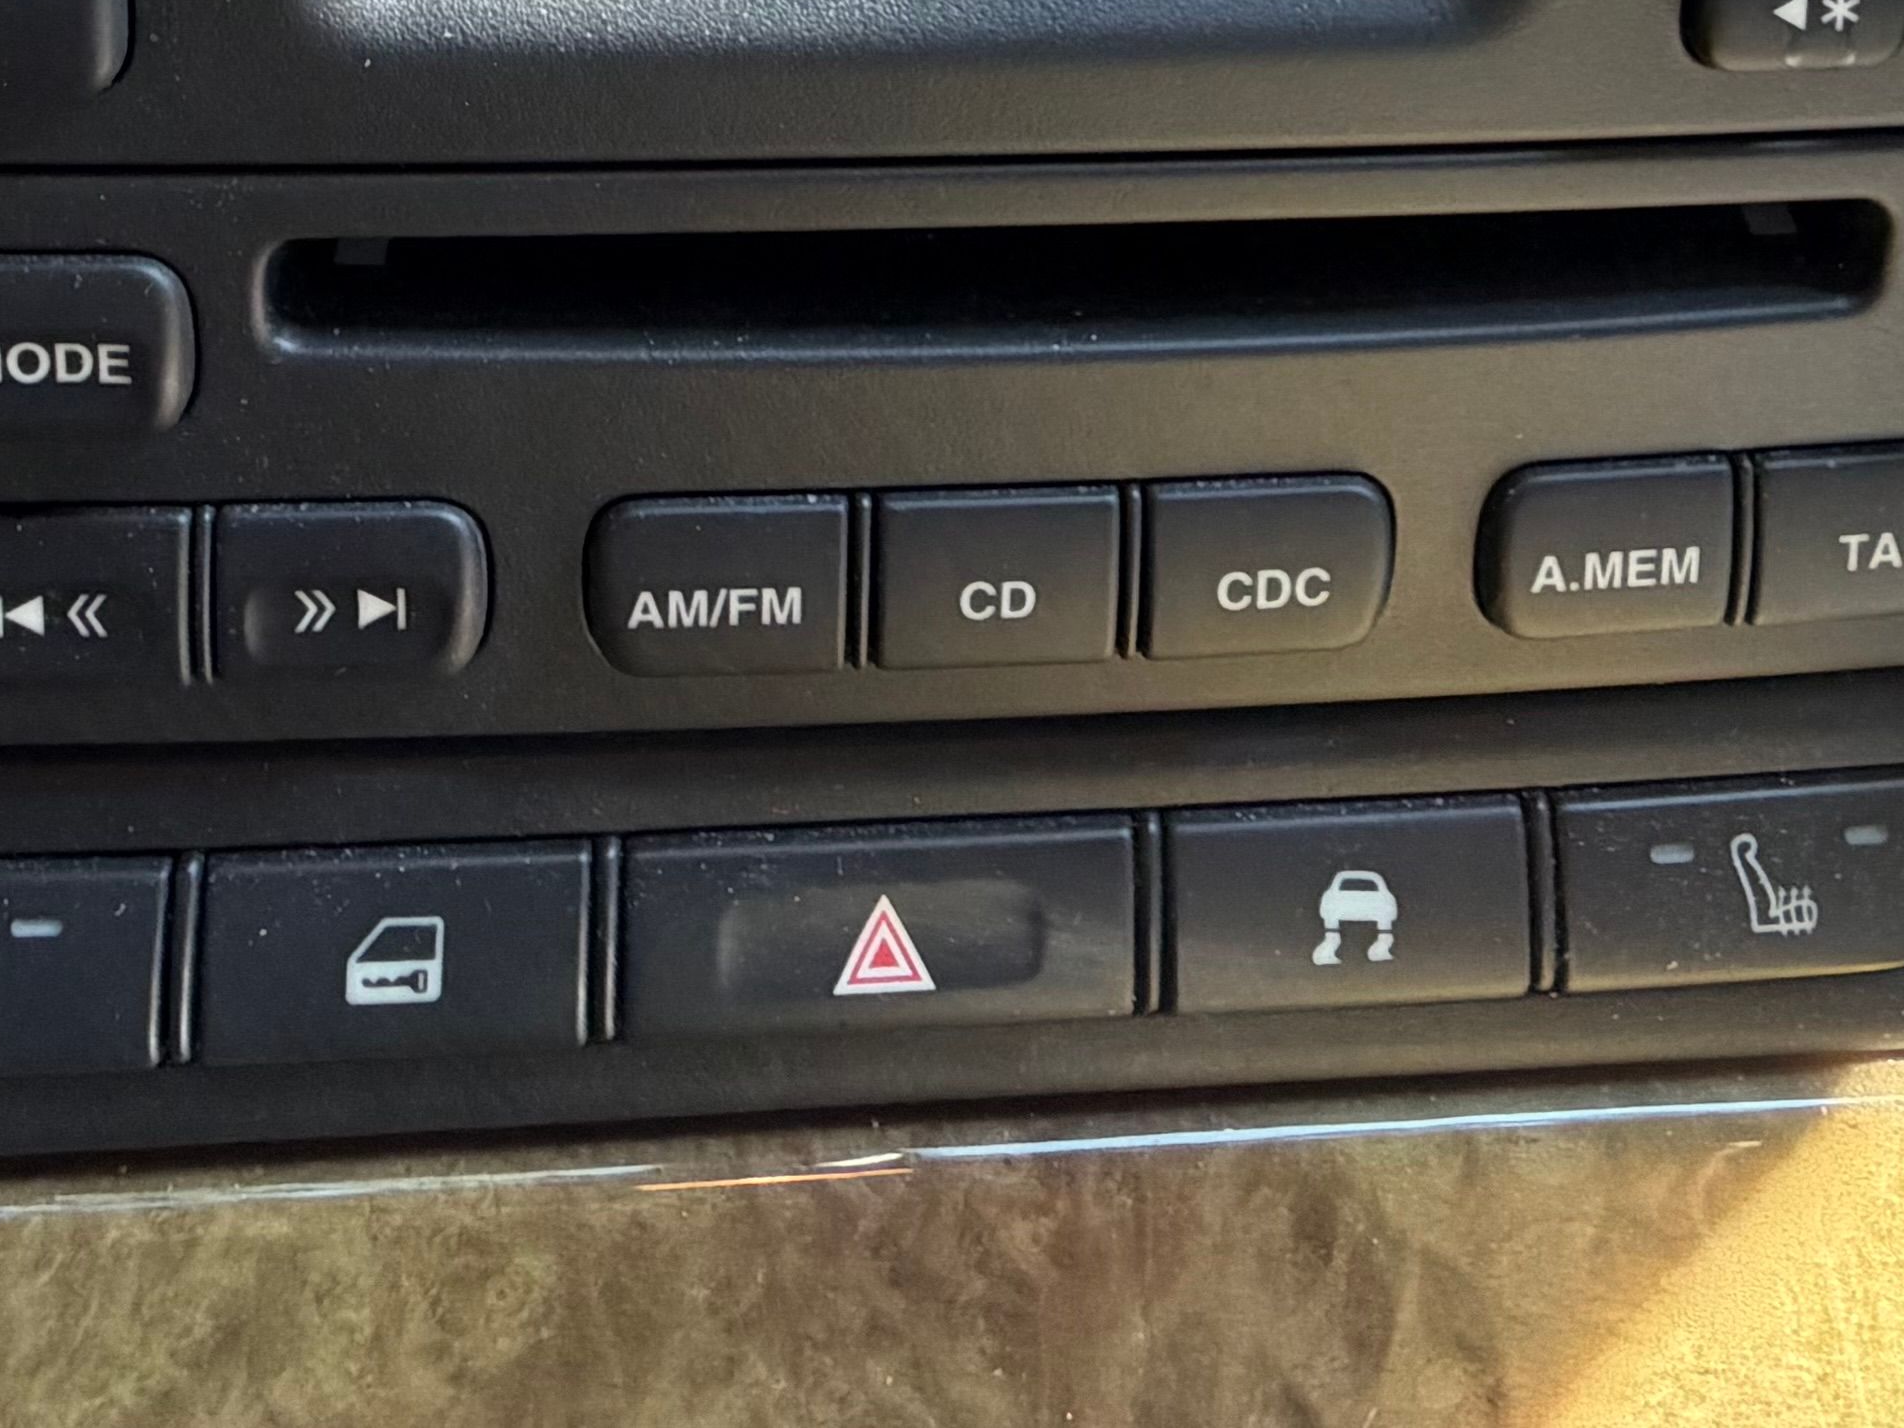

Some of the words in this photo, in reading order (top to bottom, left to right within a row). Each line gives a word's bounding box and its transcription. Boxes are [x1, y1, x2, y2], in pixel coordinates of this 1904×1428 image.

[1528, 544, 1702, 596] A.MEM
[1837, 531, 1904, 574] TA
[627, 585, 804, 631] AM/FM
[957, 579, 1038, 623] CD
[1215, 566, 1333, 613] CDC
